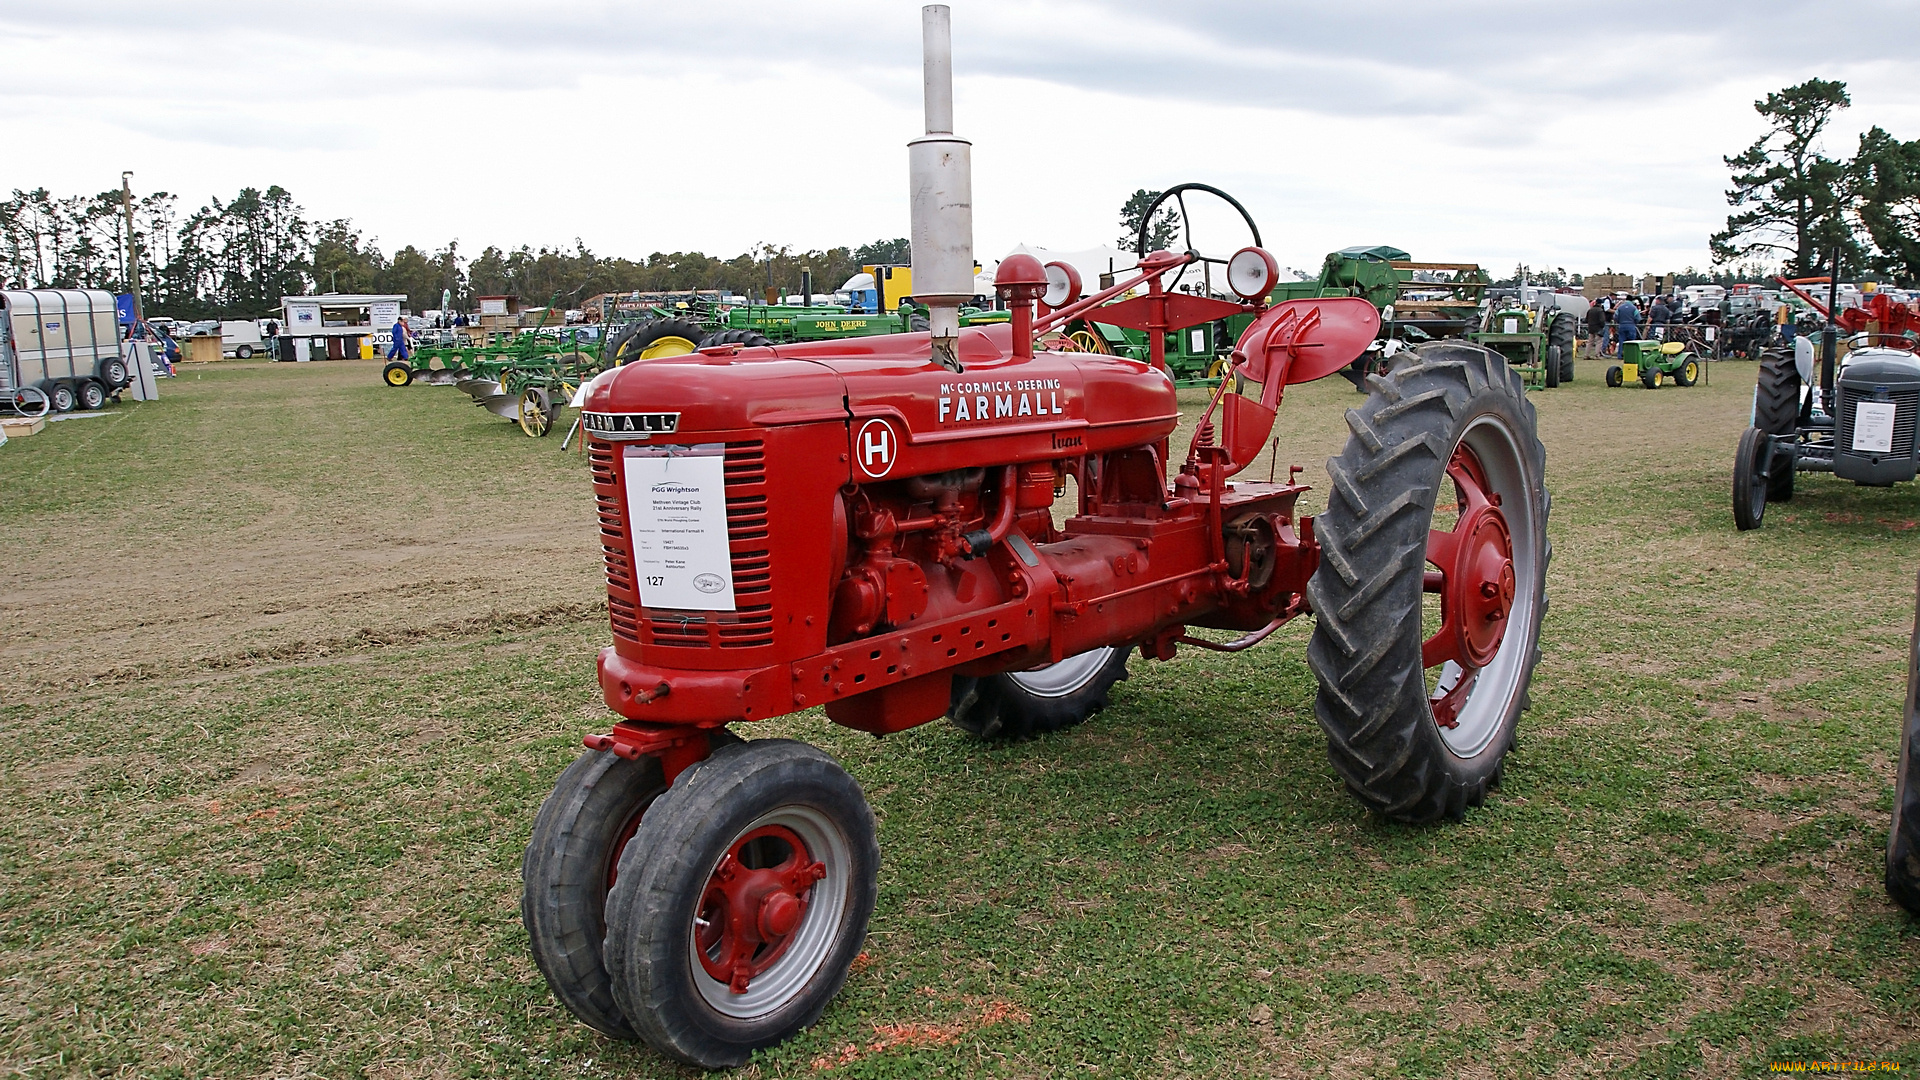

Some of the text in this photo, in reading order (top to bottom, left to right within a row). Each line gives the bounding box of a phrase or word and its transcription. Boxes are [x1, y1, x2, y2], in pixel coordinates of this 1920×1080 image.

[938, 392, 1063, 423] FARMALL
[584, 414, 673, 430] FARMALL
[864, 430, 889, 466] H
[1052, 432, 1082, 449] Ivan
[646, 576, 664, 586] 127
